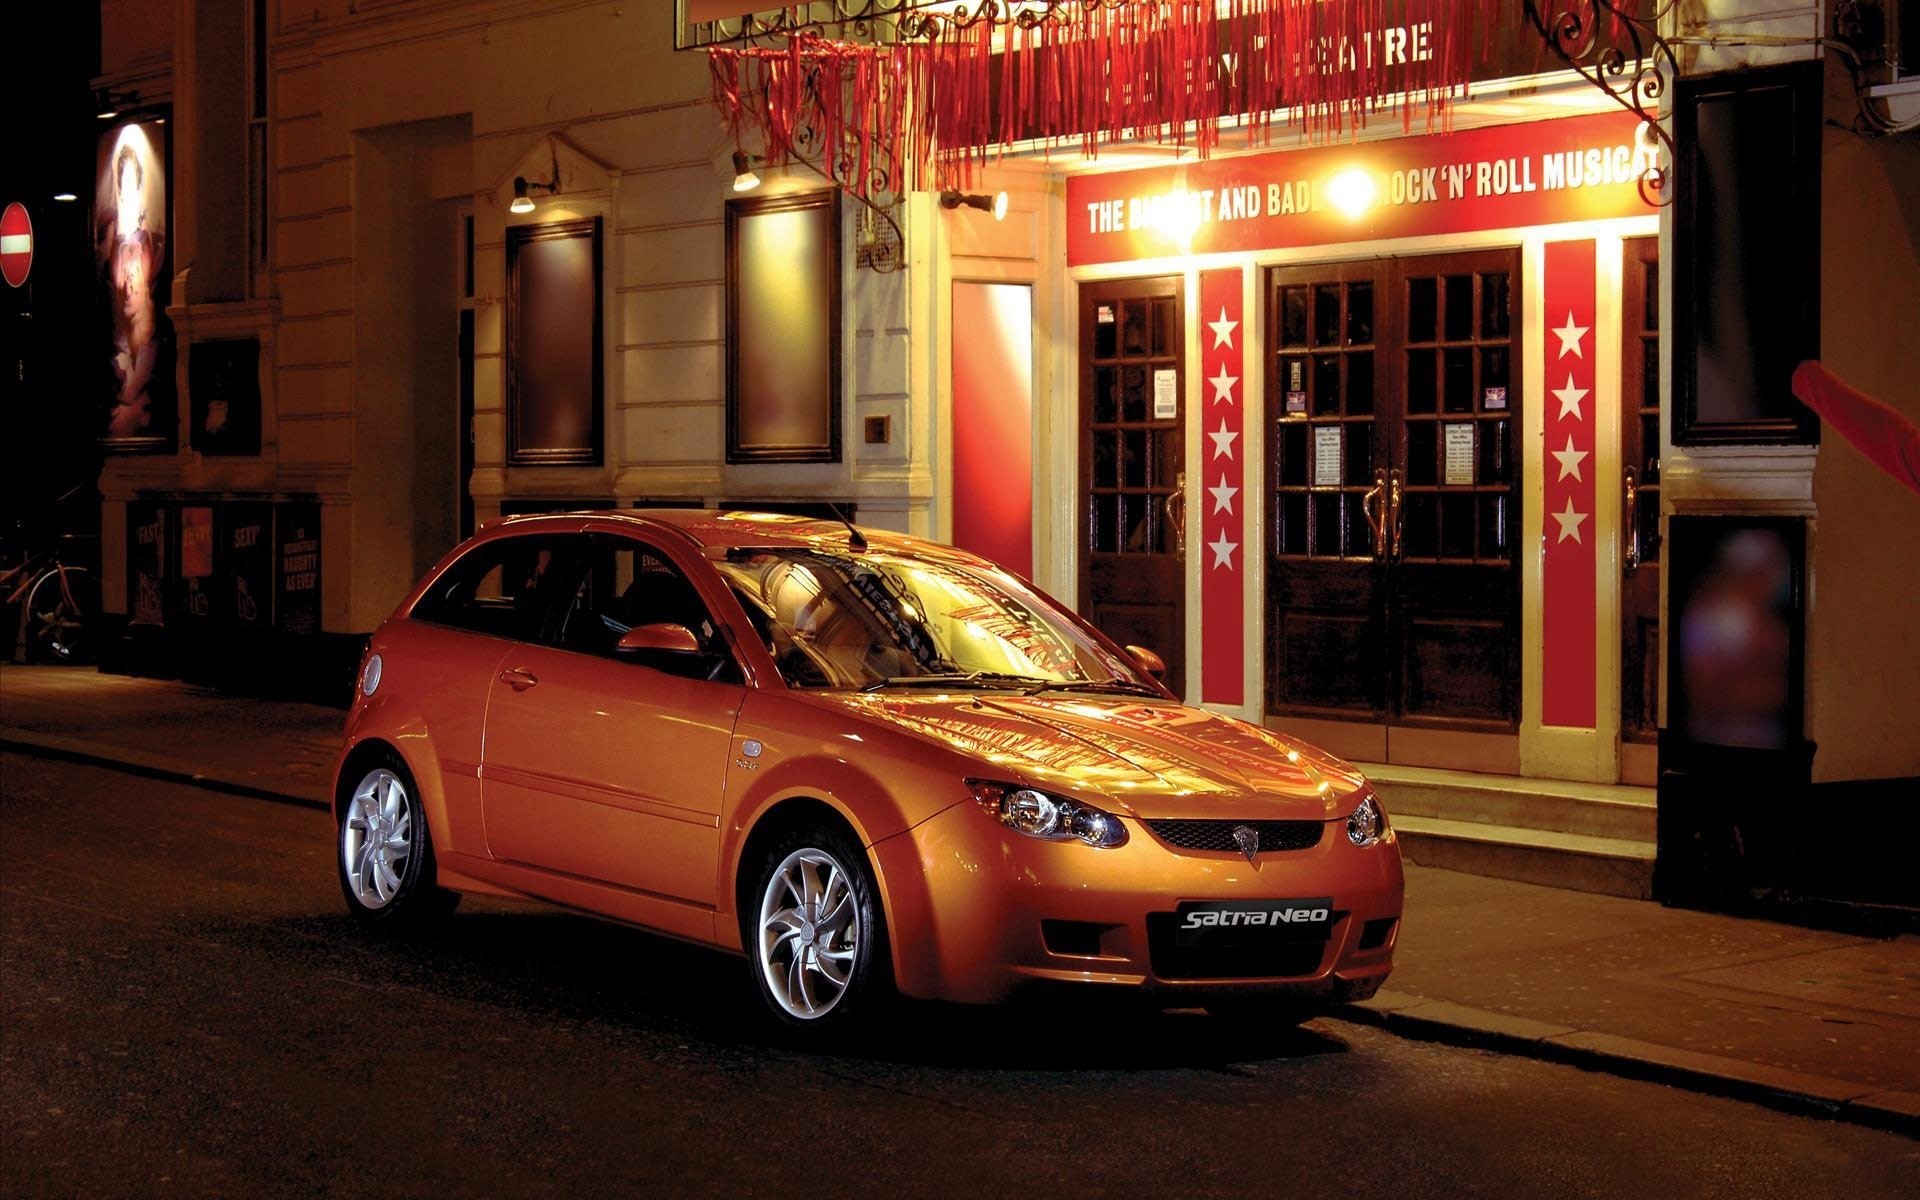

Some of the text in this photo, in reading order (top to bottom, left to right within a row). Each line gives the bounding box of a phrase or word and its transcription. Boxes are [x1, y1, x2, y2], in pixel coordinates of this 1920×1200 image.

[1088, 200, 1124, 233] THE
[1219, 186, 1261, 221] AND
[1477, 156, 1536, 197] ROLL
[1181, 908, 1328, 929] Satria Neo
